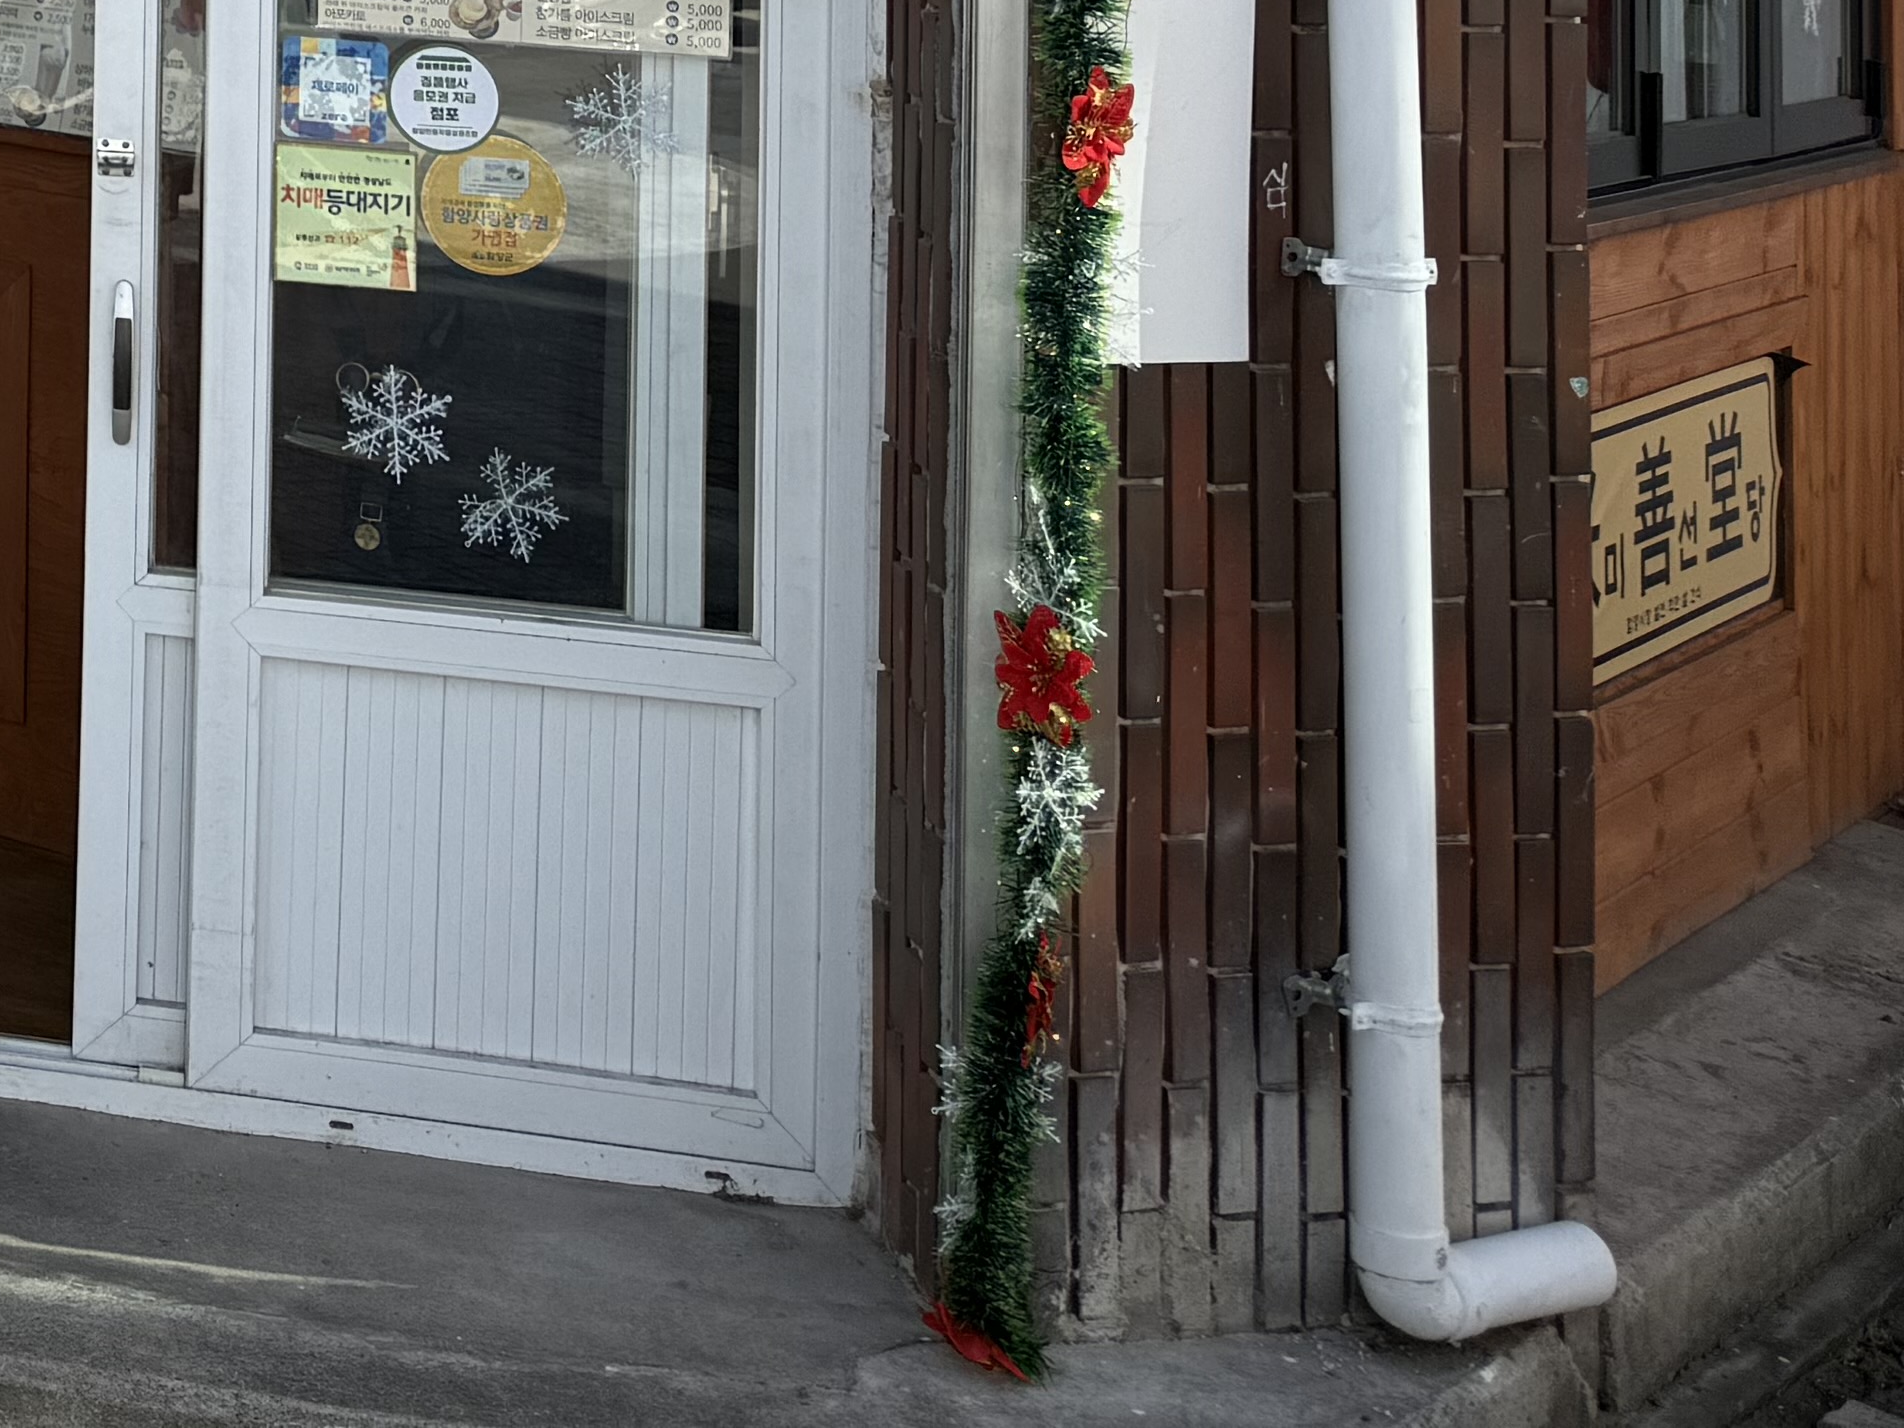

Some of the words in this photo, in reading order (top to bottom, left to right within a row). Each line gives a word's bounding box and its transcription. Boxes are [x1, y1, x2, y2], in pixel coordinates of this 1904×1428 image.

[686, 4, 723, 17] 5,000
[420, 17, 451, 29] 6,000
[574, 9, 635, 26] 아이스크림
[686, 18, 723, 31] 5,000
[686, 36, 722, 48] 5,000
[311, 79, 359, 97] 제로페이
[452, 91, 476, 104] 지급
[430, 106, 460, 122] 점포
[281, 184, 411, 217] 치매등대지기
